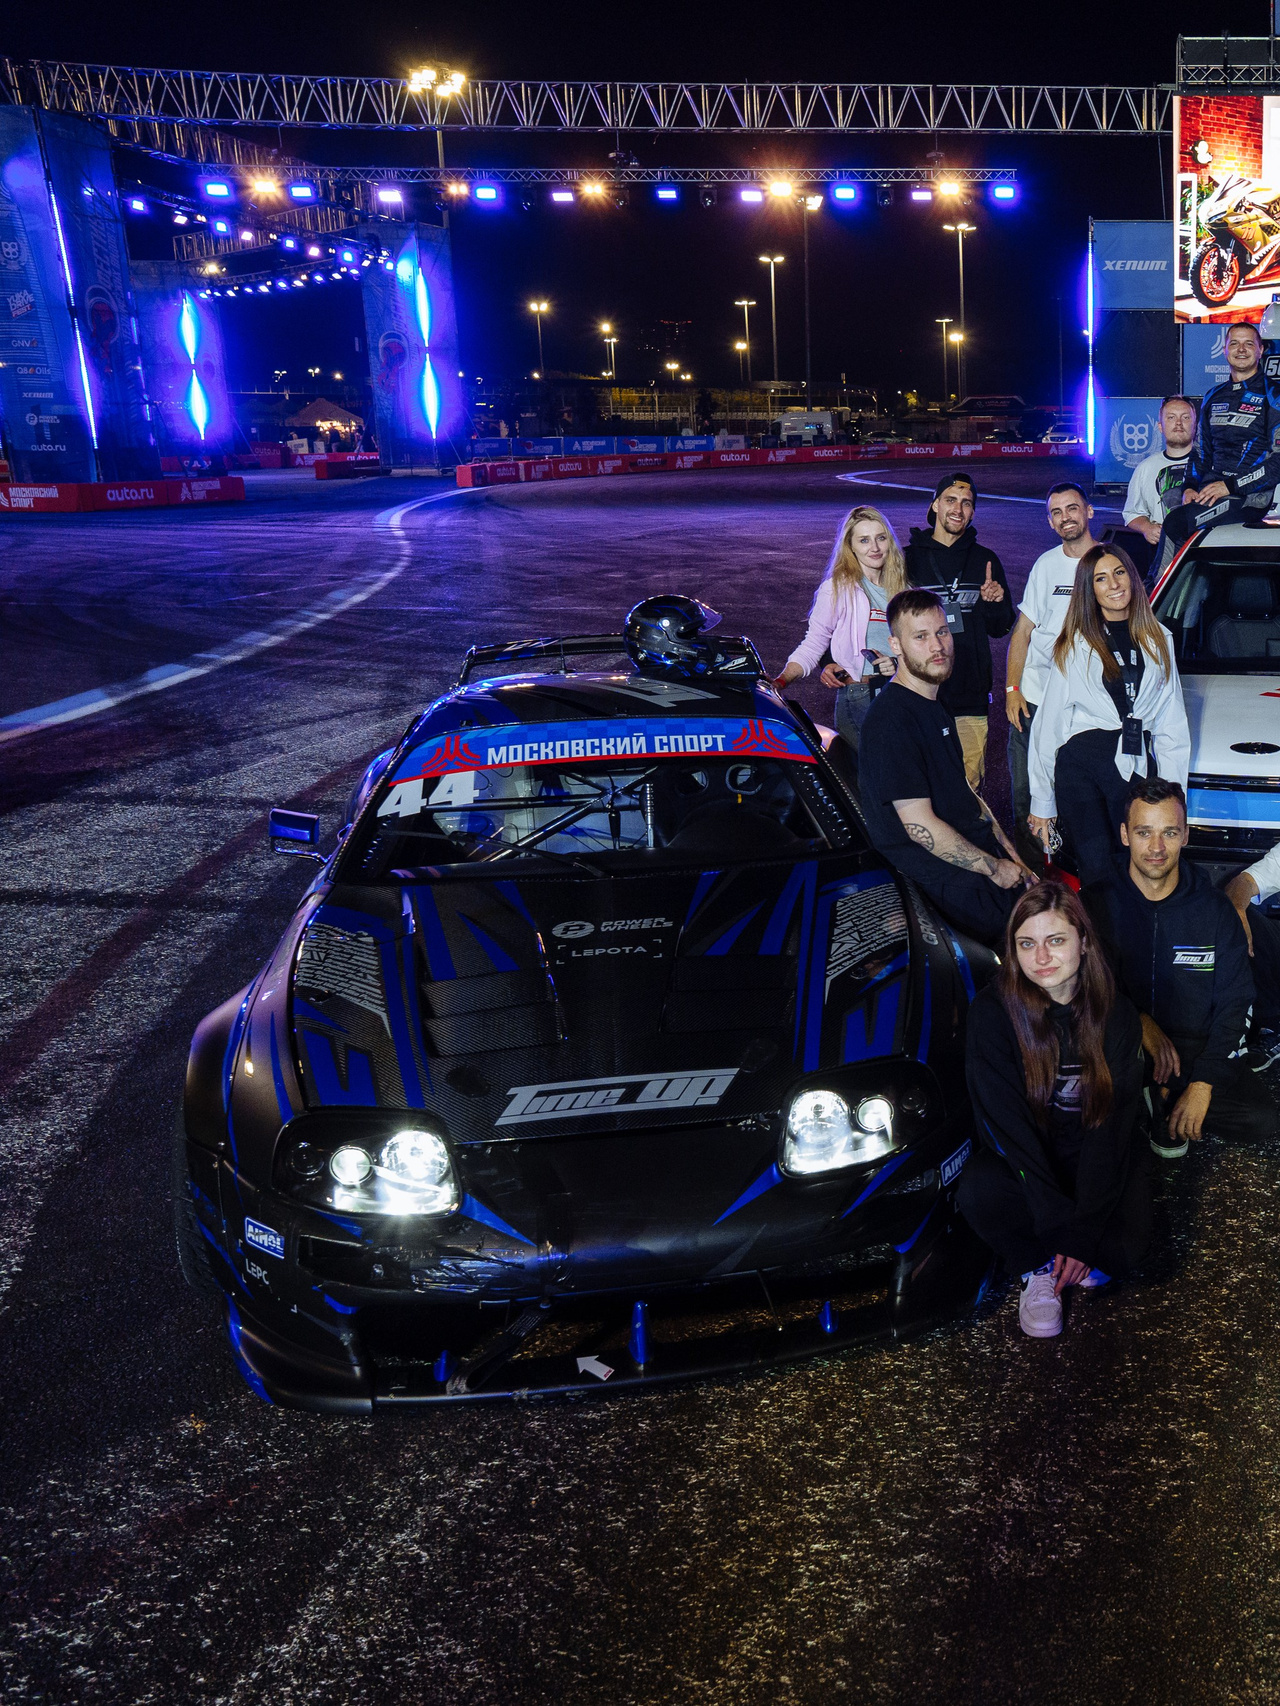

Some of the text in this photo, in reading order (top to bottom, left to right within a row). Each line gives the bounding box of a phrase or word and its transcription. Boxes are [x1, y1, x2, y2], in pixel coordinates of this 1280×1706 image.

[1102, 261, 1169, 271] XENUM
[1205, 364, 1231, 373] МОСКОВ
[1215, 374, 1230, 382] СПО
[31, 443, 66, 451] auto.ru
[905, 446, 934, 454] auto.ru
[1002, 445, 1033, 453] auto.ru
[720, 452, 750, 462] auto.ru
[814, 448, 843, 457] auto.ru
[559, 462, 582, 471] auto.ru
[637, 457, 661, 466] auto.ru
[497, 466, 515, 477] auto.ru
[107, 487, 154, 502] auto.ru
[11, 498, 34, 507] СПОРТ
[487, 732, 726, 766] МОСКОВСКИЙ СПОРТ
[376, 770, 480, 818] 44
[600, 917, 667, 928] POWER
[600, 921, 673, 933] WHEELS
[571, 946, 648, 957] LEPOTA
[1172, 951, 1201, 964] Time
[494, 1078, 632, 1126] Time
[247, 1223, 284, 1251] AIMOL
